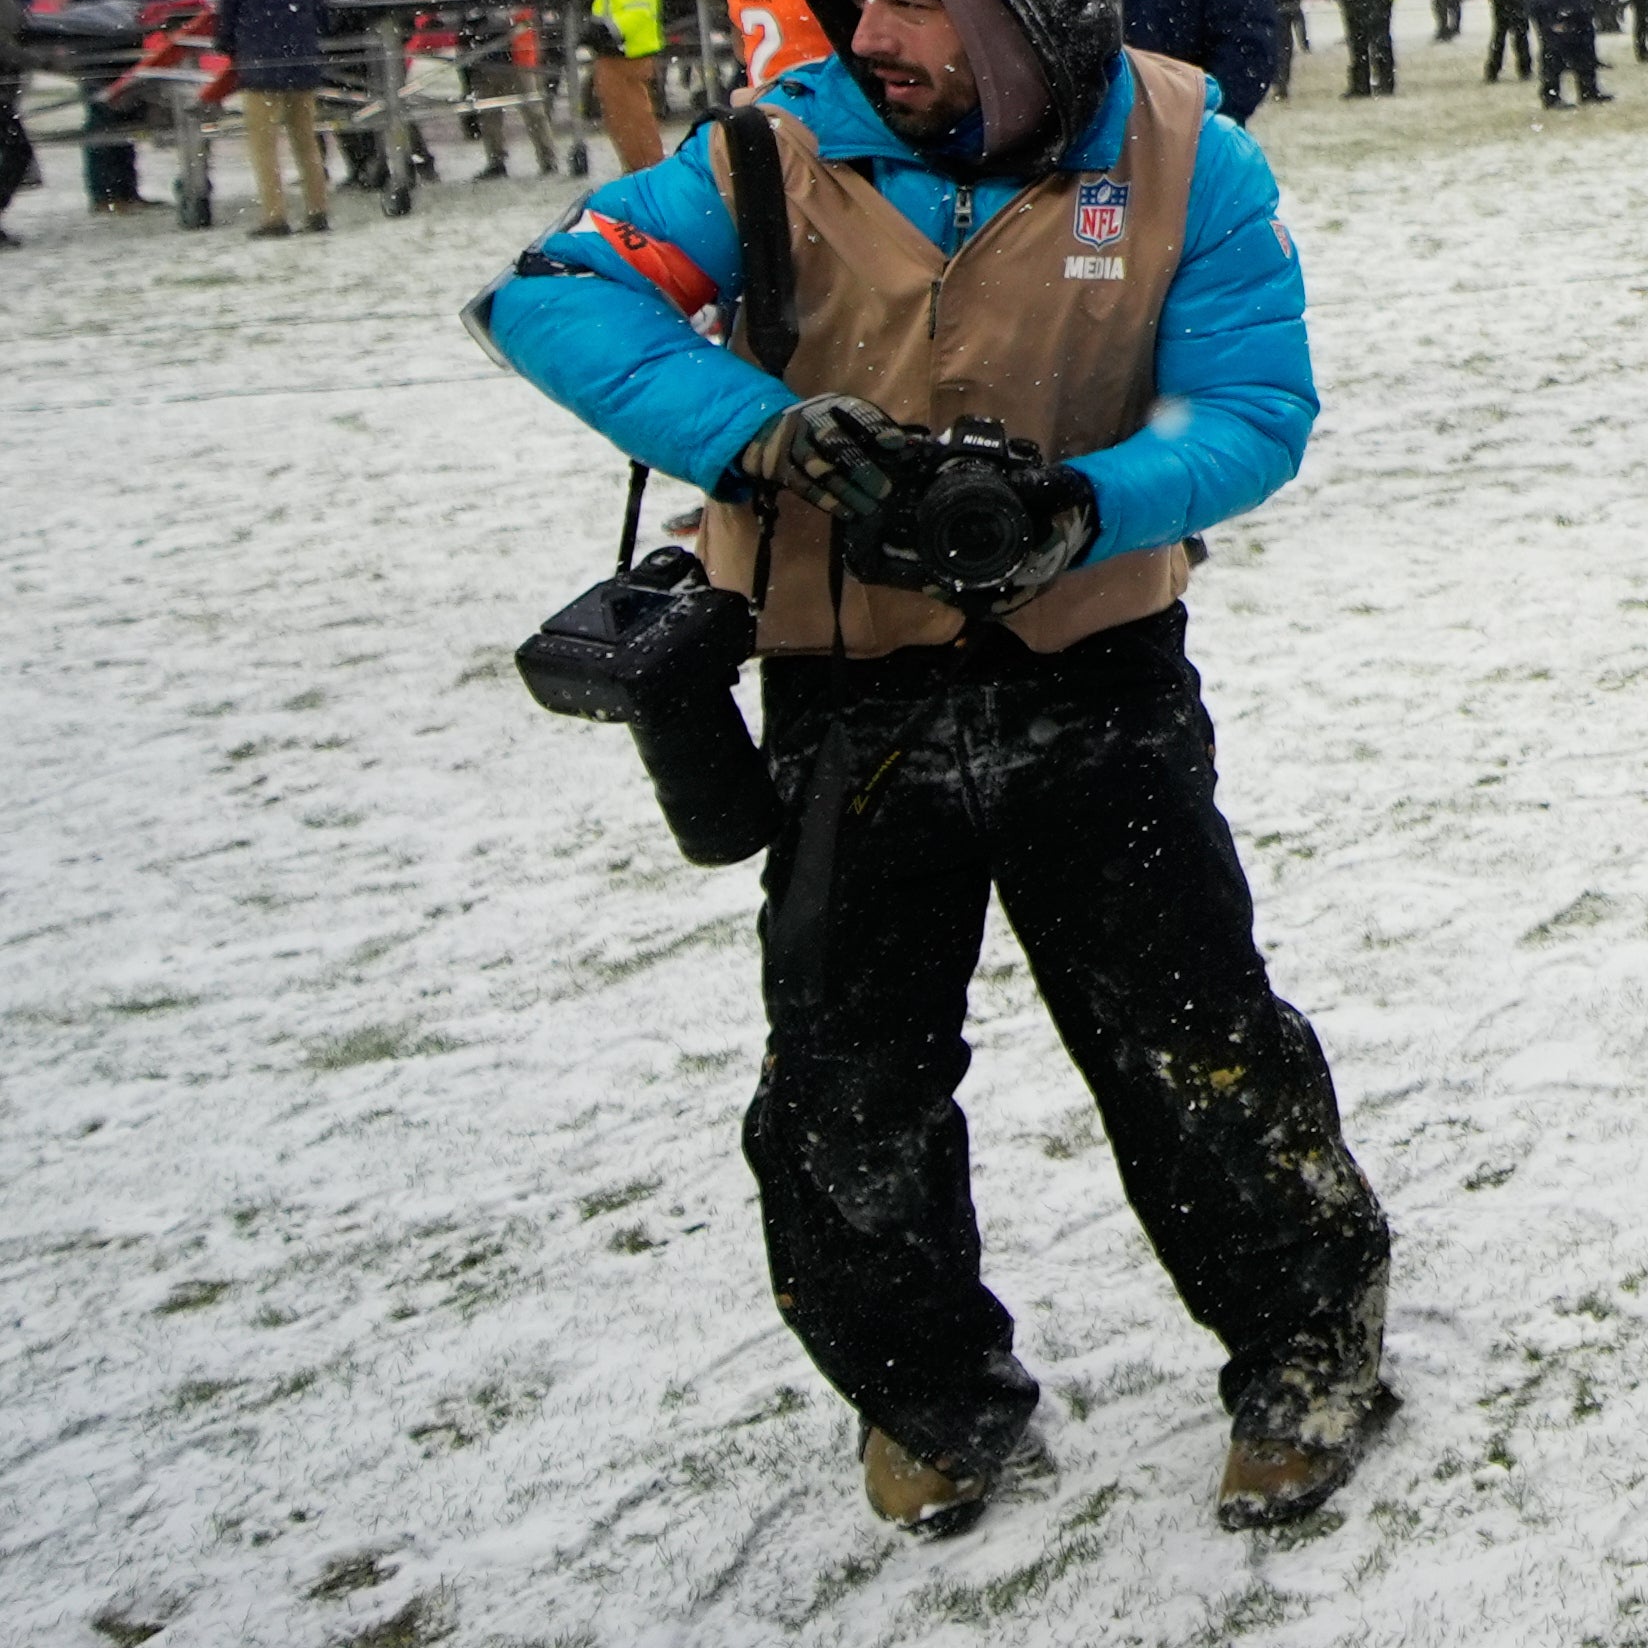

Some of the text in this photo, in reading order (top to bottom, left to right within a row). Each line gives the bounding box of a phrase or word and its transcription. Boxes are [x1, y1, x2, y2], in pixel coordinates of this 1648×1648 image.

[1081, 208, 1119, 239] NFL
[1064, 256, 1125, 280] MEDIA
[963, 434, 1000, 449] Nikon
